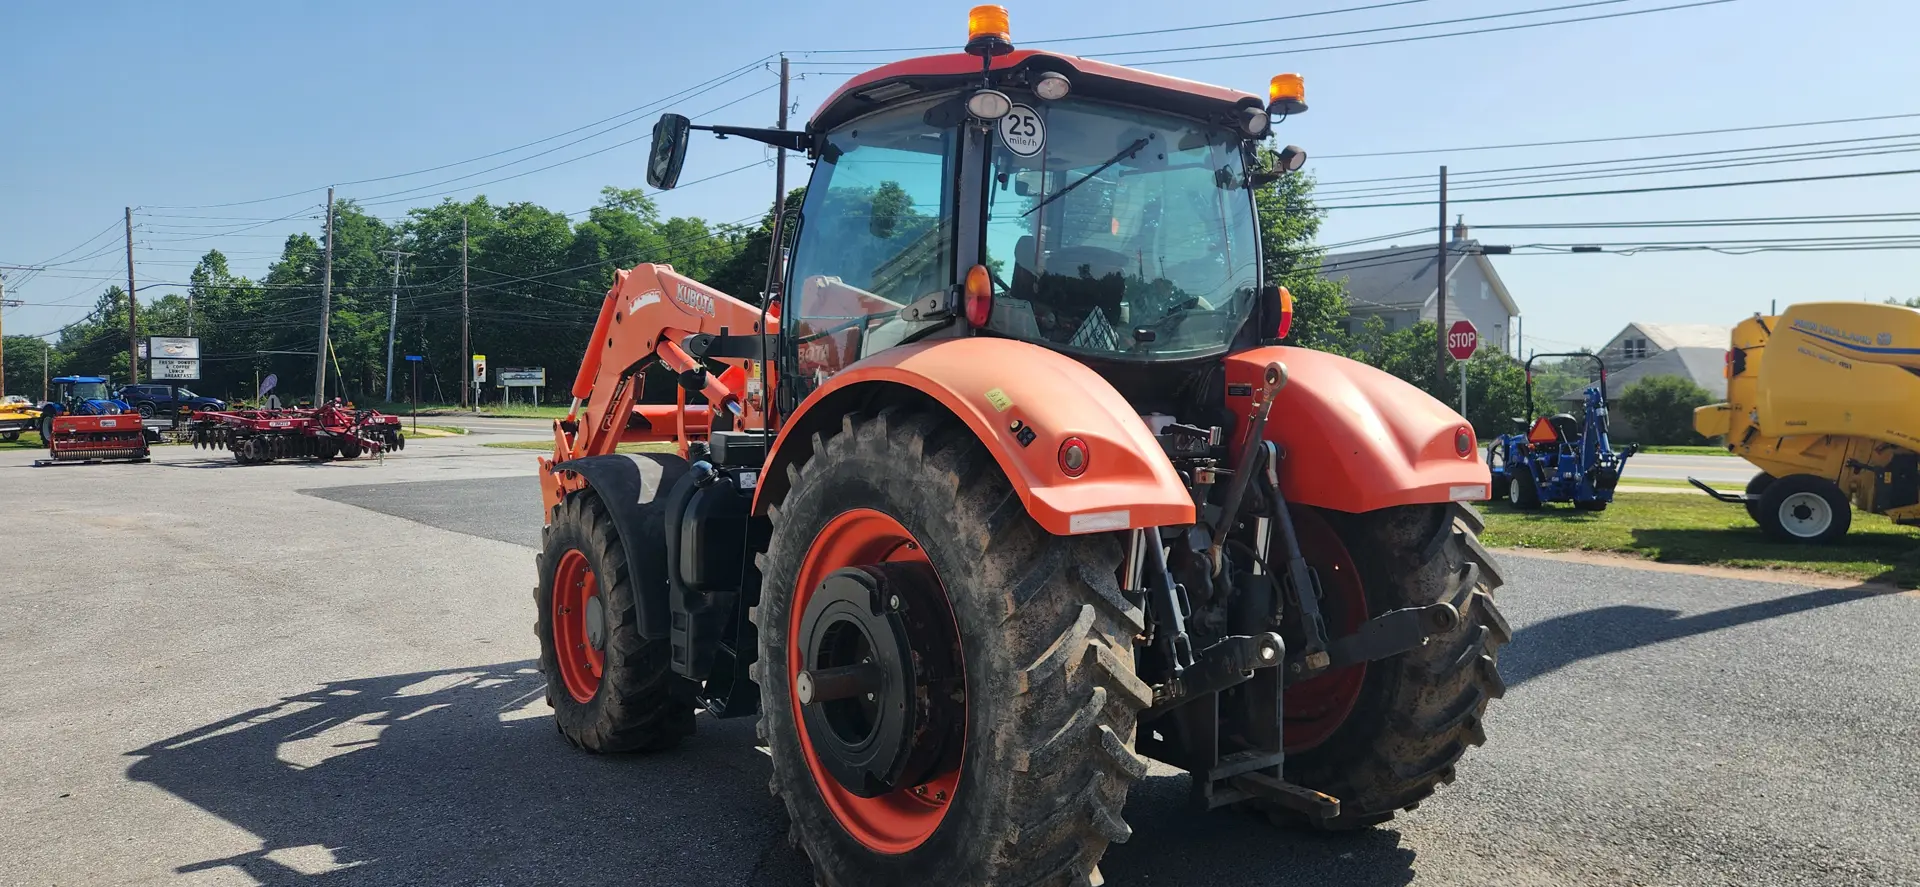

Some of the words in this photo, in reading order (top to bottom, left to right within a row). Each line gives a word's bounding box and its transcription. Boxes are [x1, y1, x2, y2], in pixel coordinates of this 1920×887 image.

[1008, 114, 1036, 137] 25
[1009, 137, 1037, 147] mile/h
[676, 283, 715, 318] KUBOTA
[1449, 332, 1476, 349] STOP
